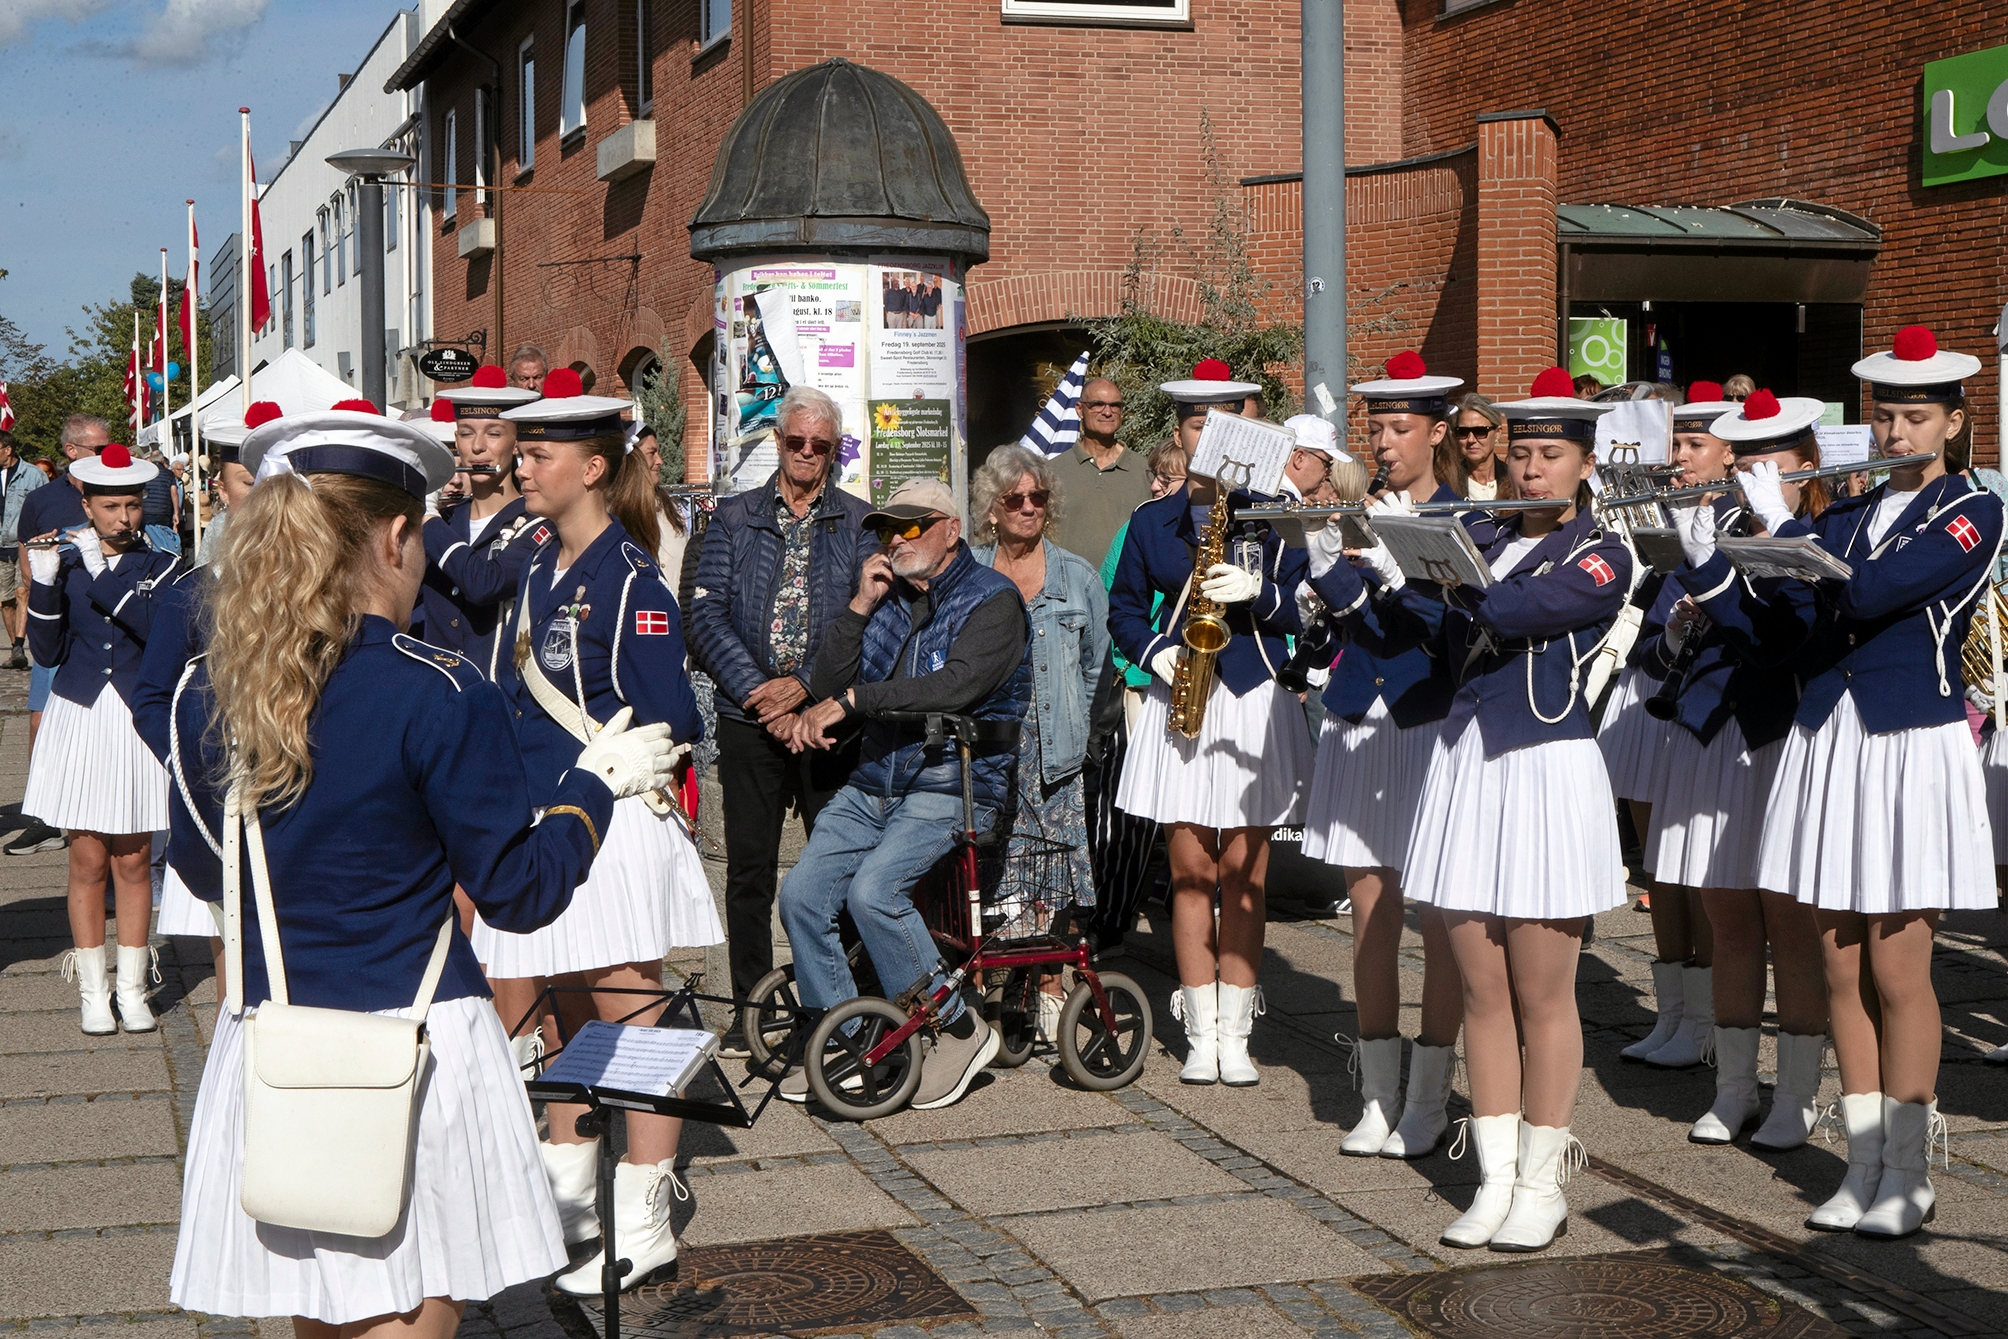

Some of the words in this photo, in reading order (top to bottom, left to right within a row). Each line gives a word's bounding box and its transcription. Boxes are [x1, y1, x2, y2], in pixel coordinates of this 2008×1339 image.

[1877, 389, 1927, 399] HELSINGØR
[876, 426, 915, 439] Fredensborg
[916, 426, 948, 437] Slotsmarked
[1513, 424, 1563, 433] HELSINGØR
